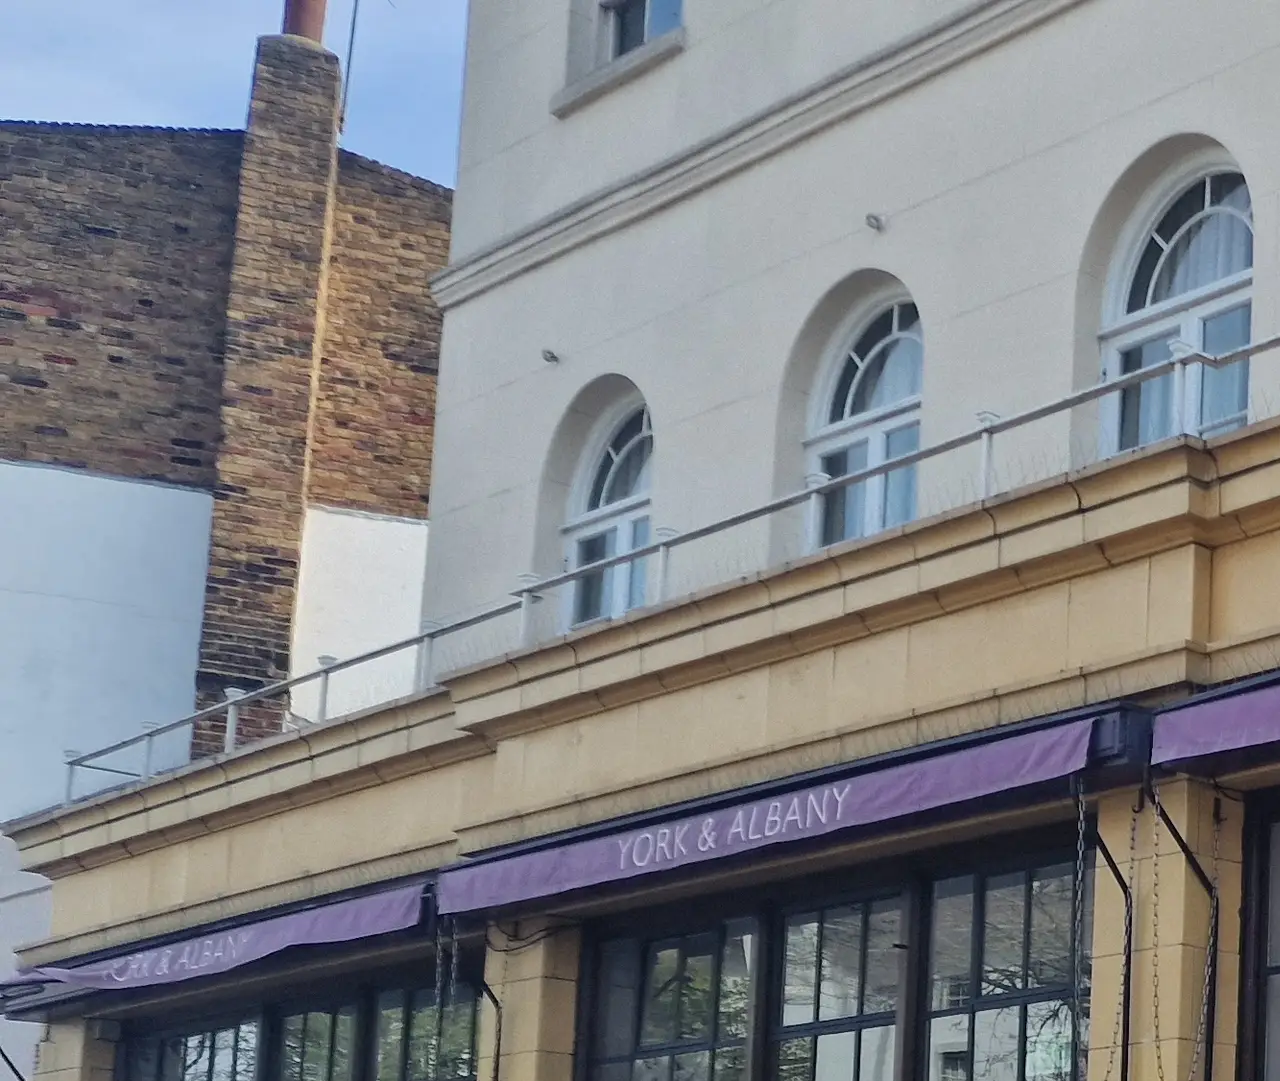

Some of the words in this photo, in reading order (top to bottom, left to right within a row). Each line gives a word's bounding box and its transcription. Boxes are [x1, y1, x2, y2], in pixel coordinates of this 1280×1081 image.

[618, 824, 688, 870] YORK
[697, 818, 716, 851] &
[727, 785, 850, 843] ALBANY
